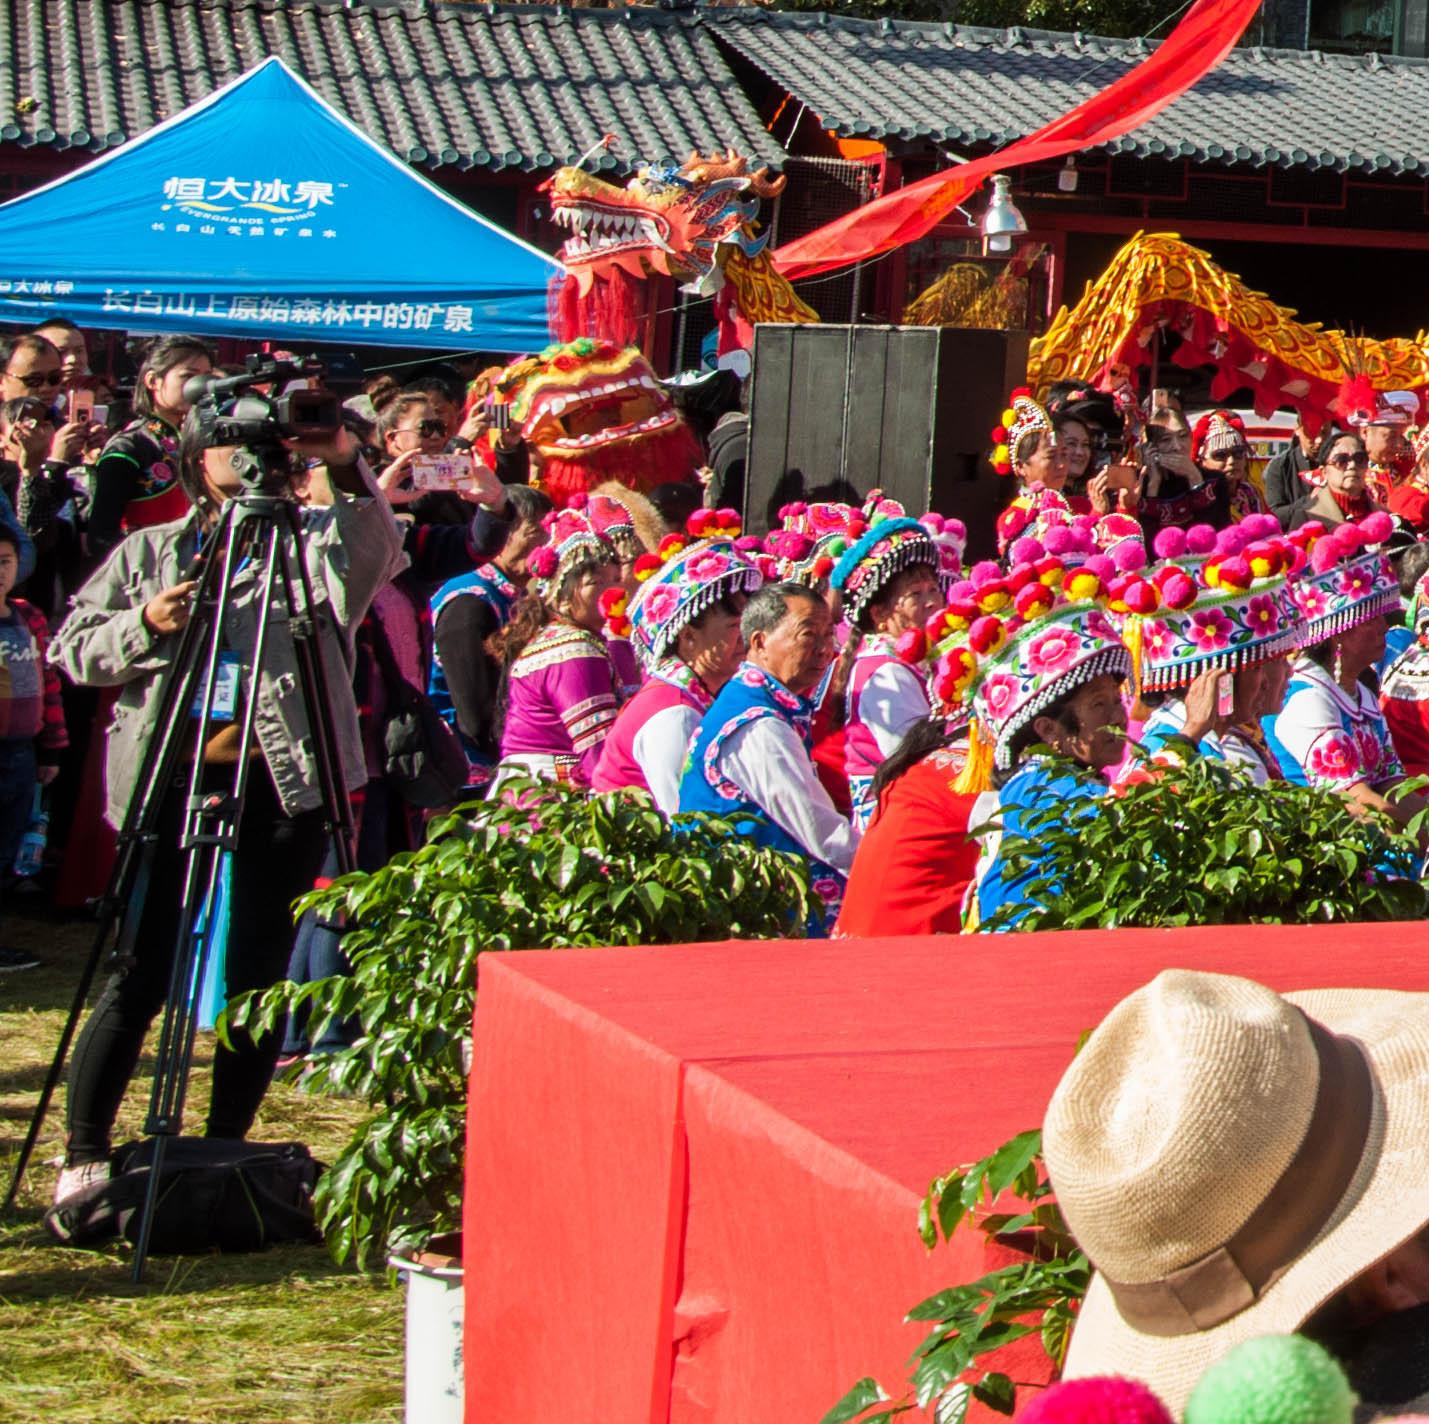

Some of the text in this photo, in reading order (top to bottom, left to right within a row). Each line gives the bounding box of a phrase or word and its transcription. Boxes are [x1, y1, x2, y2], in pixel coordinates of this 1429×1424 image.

[162, 176, 335, 210] 恒大冰泉
[180, 206, 317, 225] EVERGRANDE SPRING
